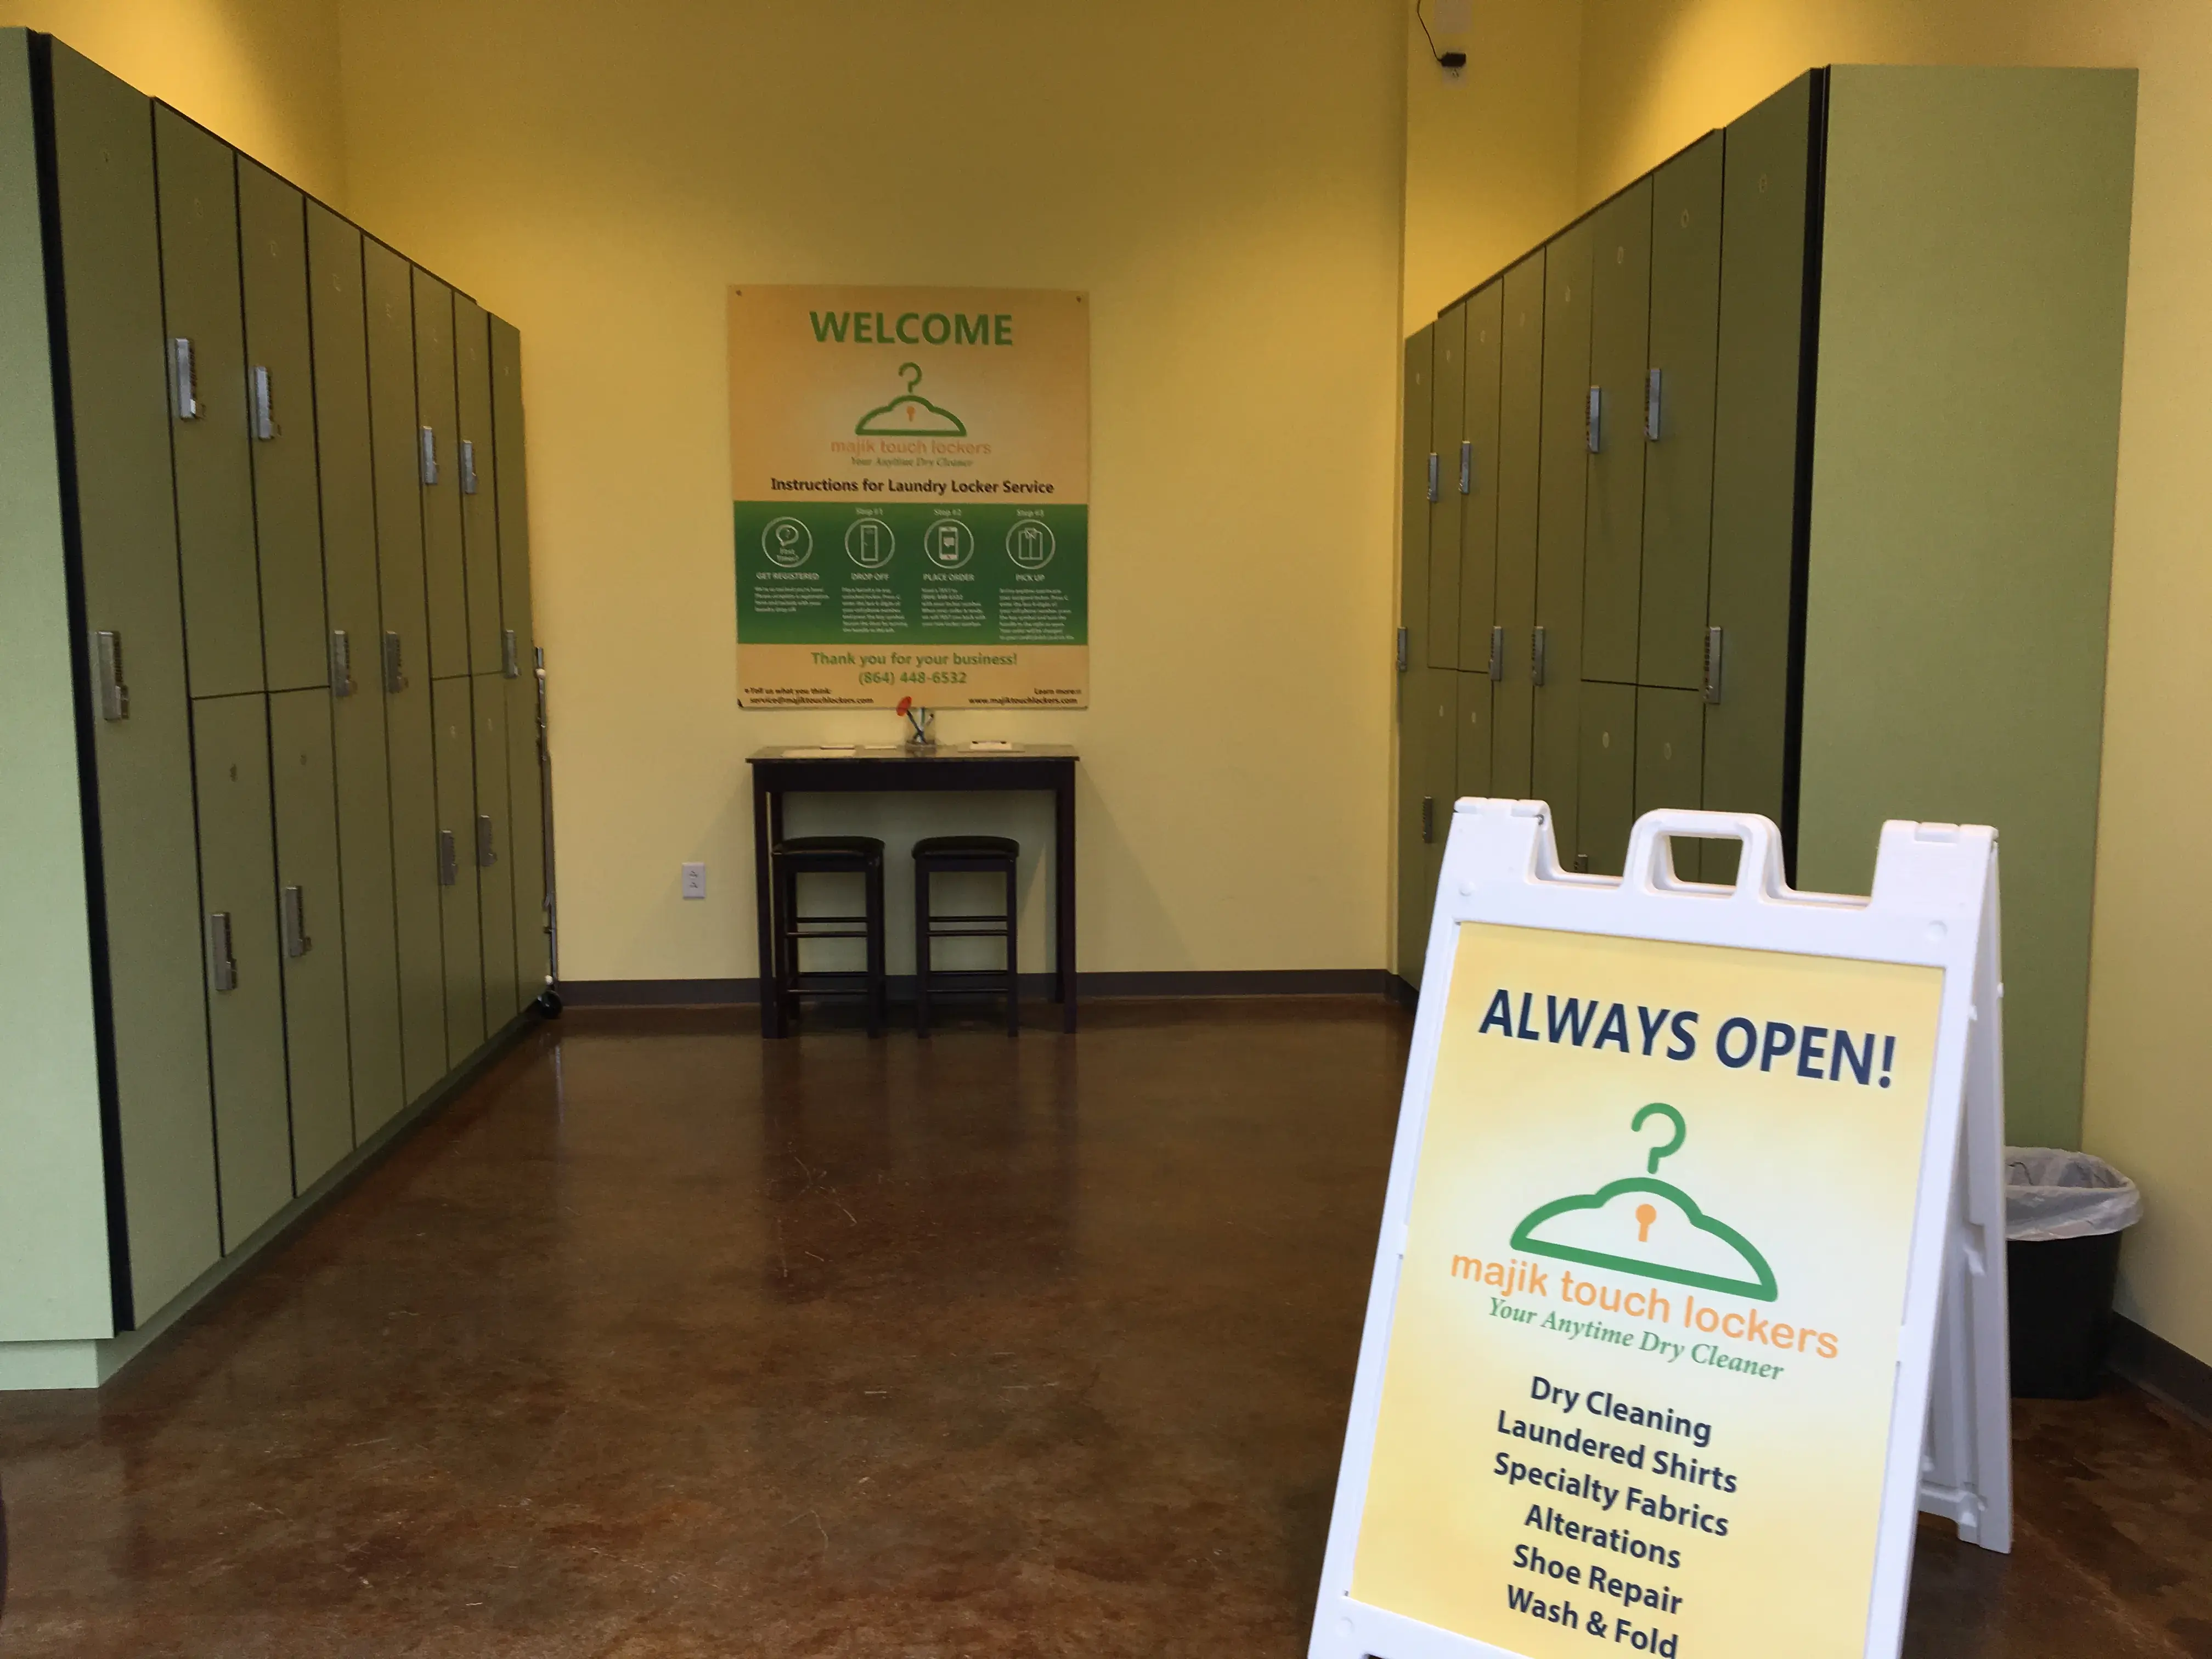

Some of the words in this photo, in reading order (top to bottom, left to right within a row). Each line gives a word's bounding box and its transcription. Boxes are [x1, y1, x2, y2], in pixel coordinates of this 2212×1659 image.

[809, 311, 1013, 346] WELCOME
[831, 439, 876, 456] majik
[880, 439, 927, 454] touch
[932, 441, 991, 455] lockers
[771, 477, 858, 492] Instructions
[862, 479, 884, 492] for
[888, 479, 947, 495] Laundry
[951, 480, 998, 494] Locker
[1003, 481, 1054, 494] Service
[811, 652, 856, 665] Thank
[860, 655, 886, 668] you
[890, 652, 912, 665] for
[916, 655, 949, 668] your
[953, 652, 1017, 665] business!
[859, 671, 895, 686] (864)
[900, 671, 967, 684] 448-6532
[1479, 989, 1699, 1060] ALWAYS
[1716, 1018, 1895, 1088] OPEN!
[1451, 1254, 1548, 1297] majik
[1561, 1271, 1671, 1323] touch
[1684, 1295, 1838, 1359] lockers
[1489, 1297, 1538, 1325] Your
[1540, 1311, 1634, 1347] Anytime
[1638, 1331, 1685, 1363] Dry
[1690, 1344, 1785, 1381] Cleaner
[1531, 1376, 1580, 1413] Dry
[1586, 1390, 1712, 1448] Cleaning
[1498, 1410, 1645, 1469] Laundered
[1651, 1451, 1737, 1493] Shirts
[1494, 1452, 1620, 1511] Specialty
[1626, 1487, 1729, 1537] Fabrics
[1524, 1504, 1681, 1569] Alterations
[1513, 1544, 1582, 1585] Shoe
[1588, 1565, 1684, 1615] Repair
[1507, 1584, 1578, 1629] Wash
[1586, 1611, 1607, 1639] &
[1615, 1618, 1678, 1659] Fold
